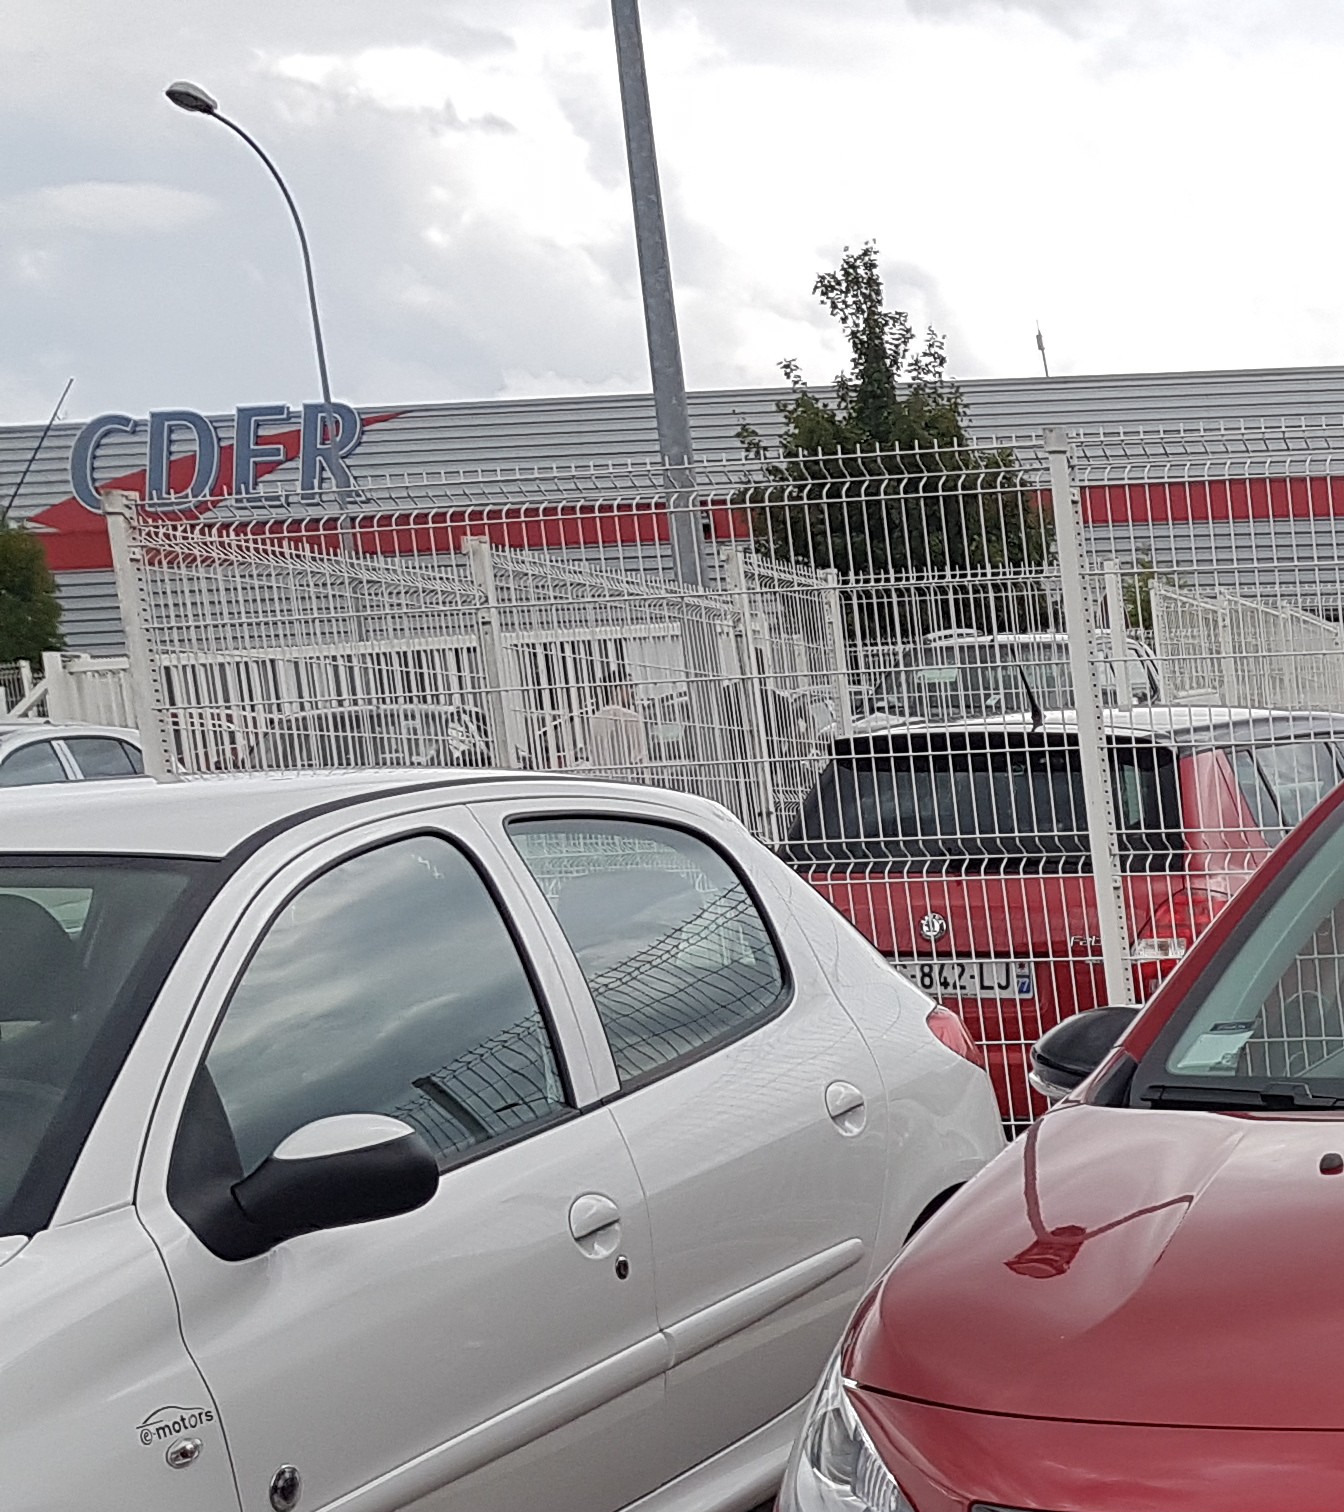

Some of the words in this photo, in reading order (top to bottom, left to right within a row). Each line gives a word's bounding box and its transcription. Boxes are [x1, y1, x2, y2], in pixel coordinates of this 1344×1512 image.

[69, 401, 369, 514] CDER
[1070, 935, 1102, 947] Fab
[895, 961, 1011, 991] -842-LJ
